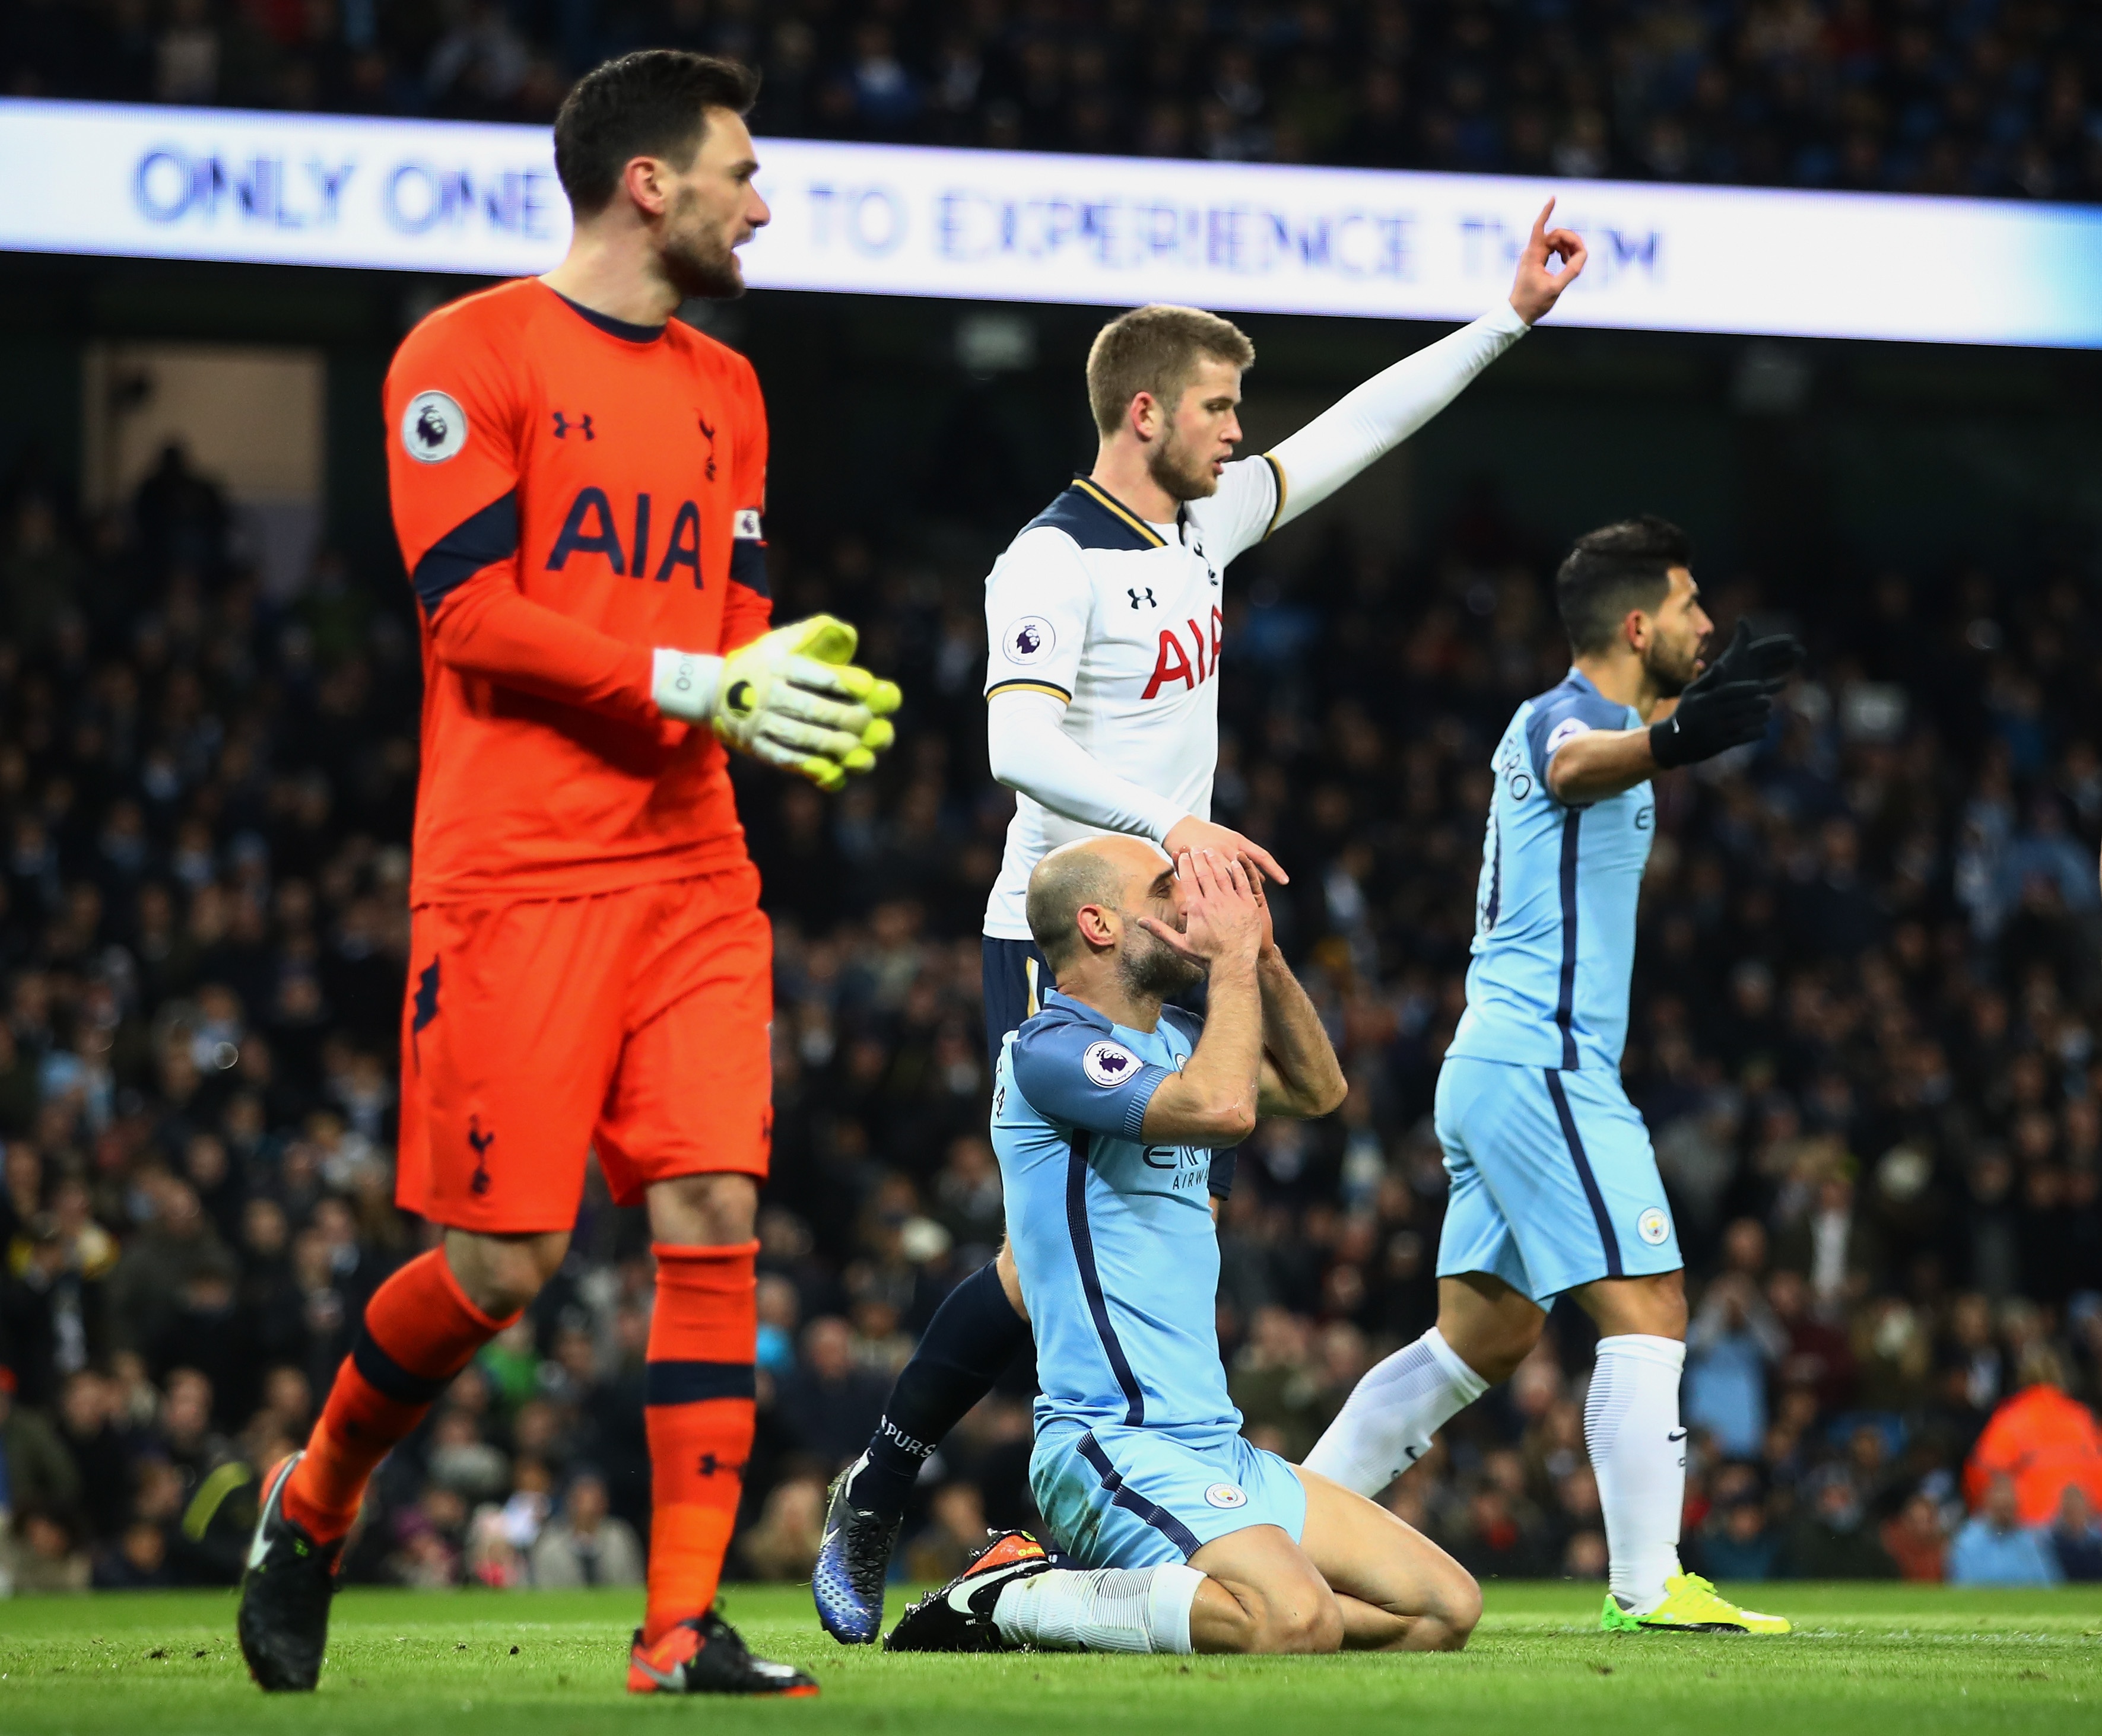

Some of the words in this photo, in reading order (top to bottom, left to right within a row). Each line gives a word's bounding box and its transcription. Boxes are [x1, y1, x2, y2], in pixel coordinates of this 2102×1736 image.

[134, 141, 357, 231] ONLY
[386, 157, 560, 240] ONE
[807, 180, 908, 260] TO
[934, 189, 1418, 282] EXPERIENCE
[545, 486, 704, 590] AIA
[1114, 1070, 1131, 1081] League
